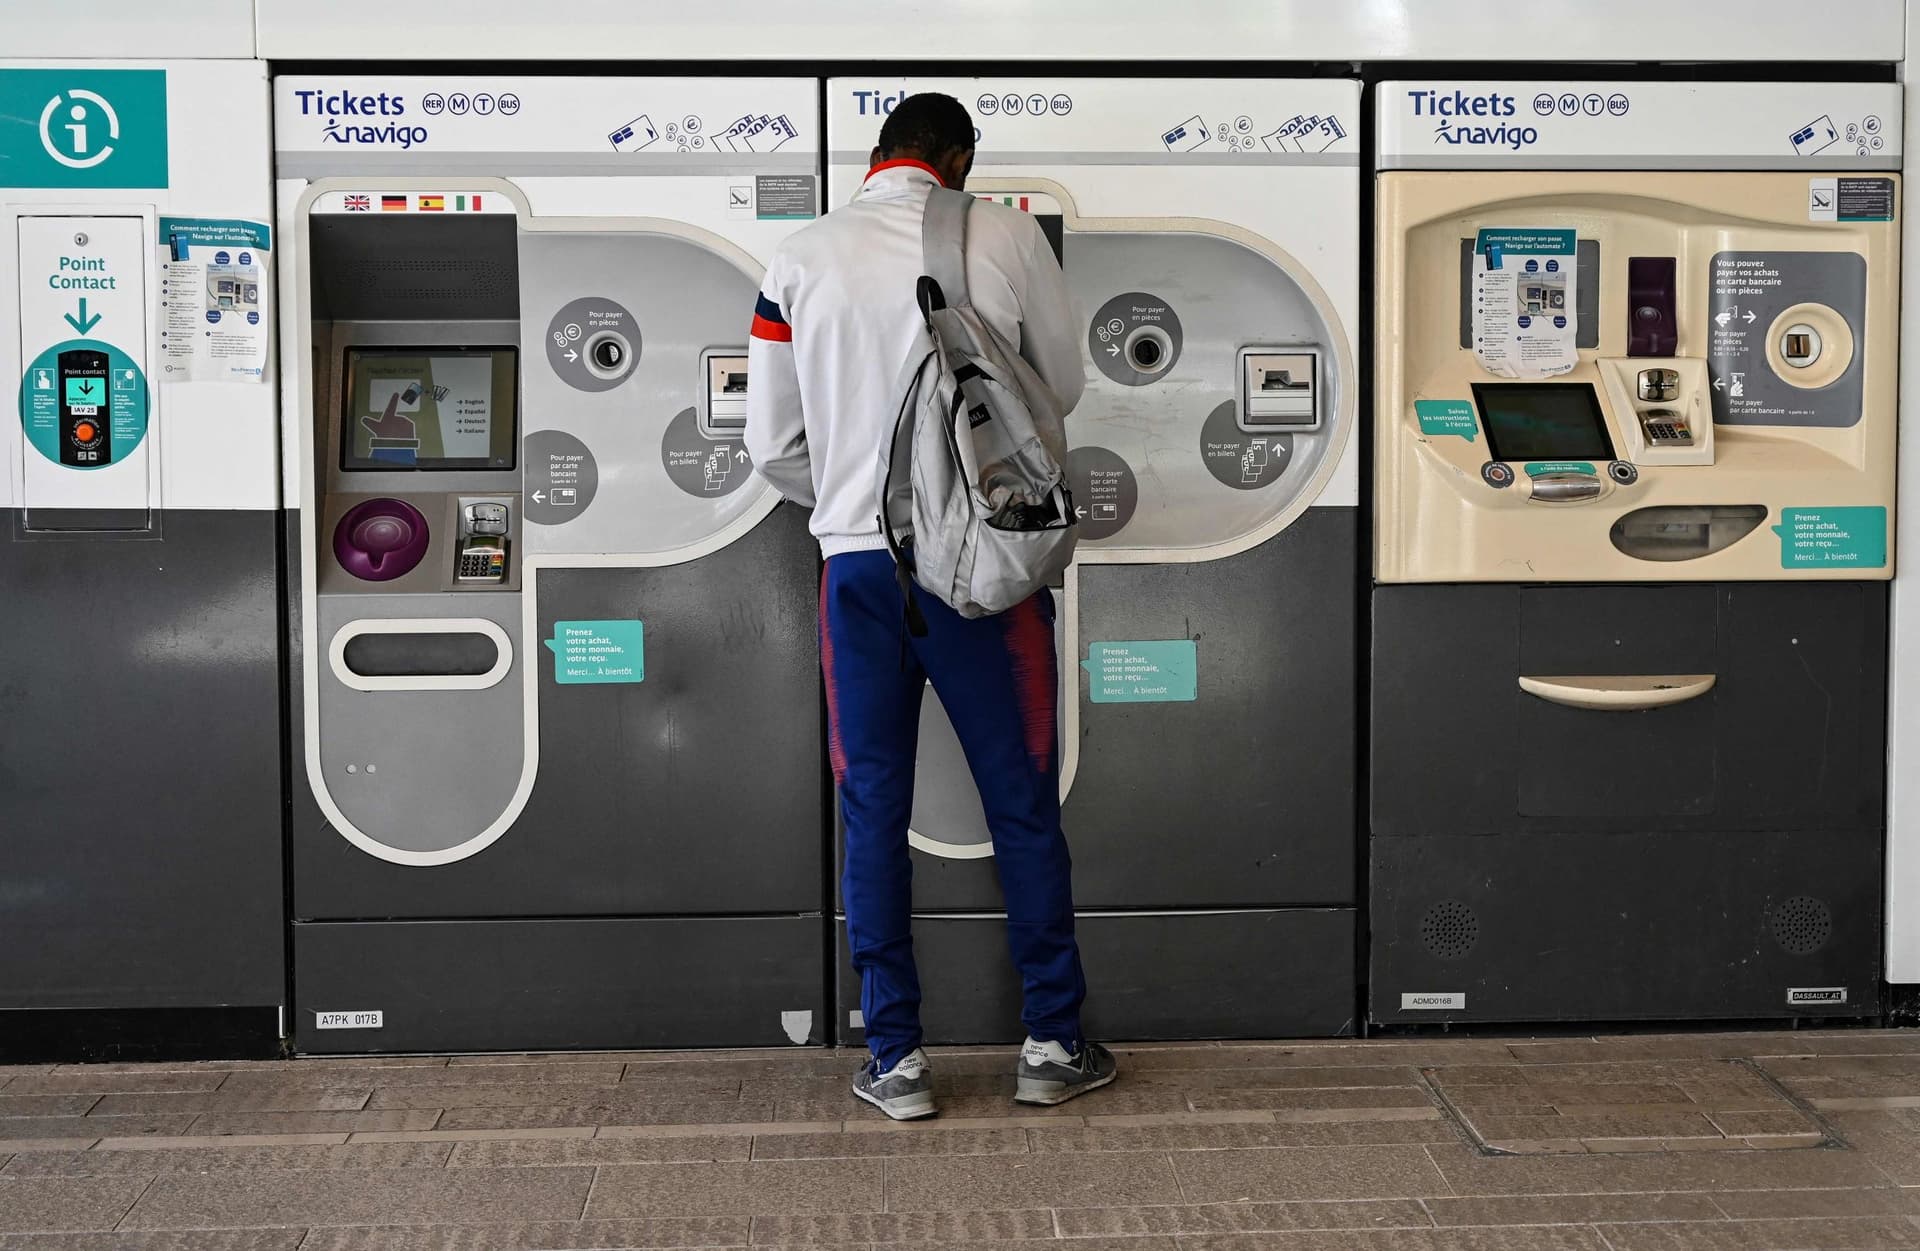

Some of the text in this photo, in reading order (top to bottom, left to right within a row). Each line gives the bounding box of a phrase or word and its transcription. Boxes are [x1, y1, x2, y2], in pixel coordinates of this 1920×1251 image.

[295, 90, 404, 115] Tickets
[425, 99, 442, 109] RER
[500, 99, 518, 109] BUS
[979, 100, 996, 110] RER
[1053, 100, 1070, 110] BUS
[1408, 90, 1516, 117] Tickets
[1535, 100, 1553, 110] RER
[1610, 100, 1627, 110] BUS
[346, 121, 428, 149] navigo
[1457, 122, 1538, 150] navigo
[170, 224, 199, 232] Comment
[200, 225, 228, 234] recharger
[192, 233, 213, 241] Navigo
[1512, 235, 1537, 243] recharger
[60, 256, 105, 271] Point
[1717, 259, 1764, 269] Vous pouvez
[1716, 269, 1737, 277] payer
[49, 275, 116, 290] Contact
[1748, 277, 1782, 286] bancaire
[1738, 286, 1763, 295] pièces
[589, 310, 623, 320] Pour payer
[1148, 307, 1165, 315] payer
[1141, 313, 1161, 322] pièces
[598, 318, 619, 328] pièces
[1723, 338, 1742, 346] pièces
[1745, 399, 1763, 407] payer
[1758, 406, 1785, 414] bancaire
[685, 450, 702, 458] payer
[1815, 522, 1839, 531] achat,
[1815, 531, 1851, 539] monnaie,
[566, 628, 593, 636] Prenez
[566, 636, 612, 645] votre achat,
[566, 645, 625, 654] votre monnaie,
[1124, 656, 1148, 664] achat,
[605, 667, 633, 675] bientôt
[1124, 665, 1160, 673] monnaie,
[1793, 992, 1829, 1000] DASSAULT
[321, 1014, 378, 1025] A7PK 017B
[904, 1057, 917, 1065] new
